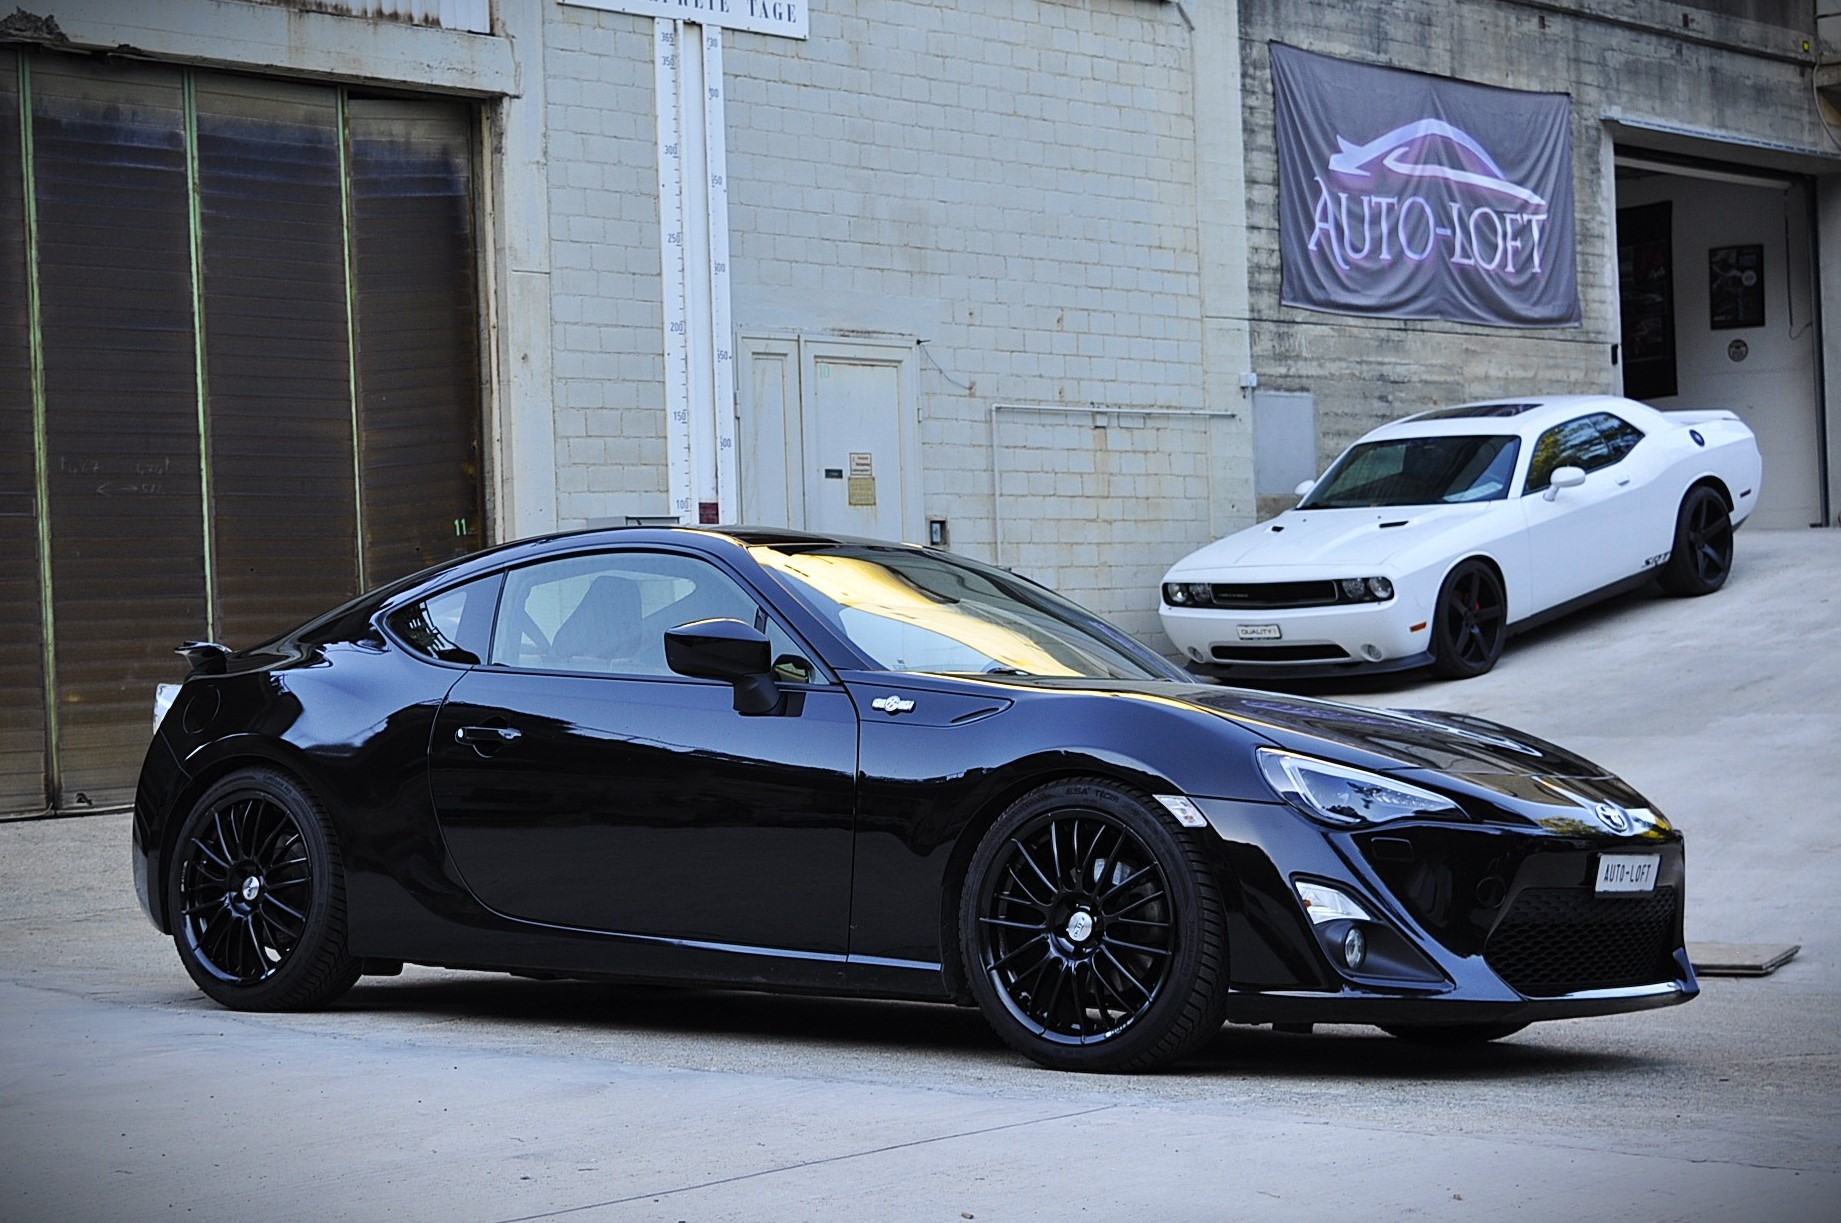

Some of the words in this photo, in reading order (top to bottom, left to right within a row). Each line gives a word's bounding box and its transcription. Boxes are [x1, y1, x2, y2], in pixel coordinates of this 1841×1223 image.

[746, 0, 796, 23] TAGE
[661, 32, 674, 43] 365
[1308, 176, 1548, 272] AUTO-LOFT
[667, 233, 680, 243] 250
[670, 322, 683, 332] 200
[674, 411, 686, 421] 150
[676, 500, 689, 510] 100
[454, 519, 467, 536] 11
[1603, 863, 1651, 883] AUTO-LOFT
